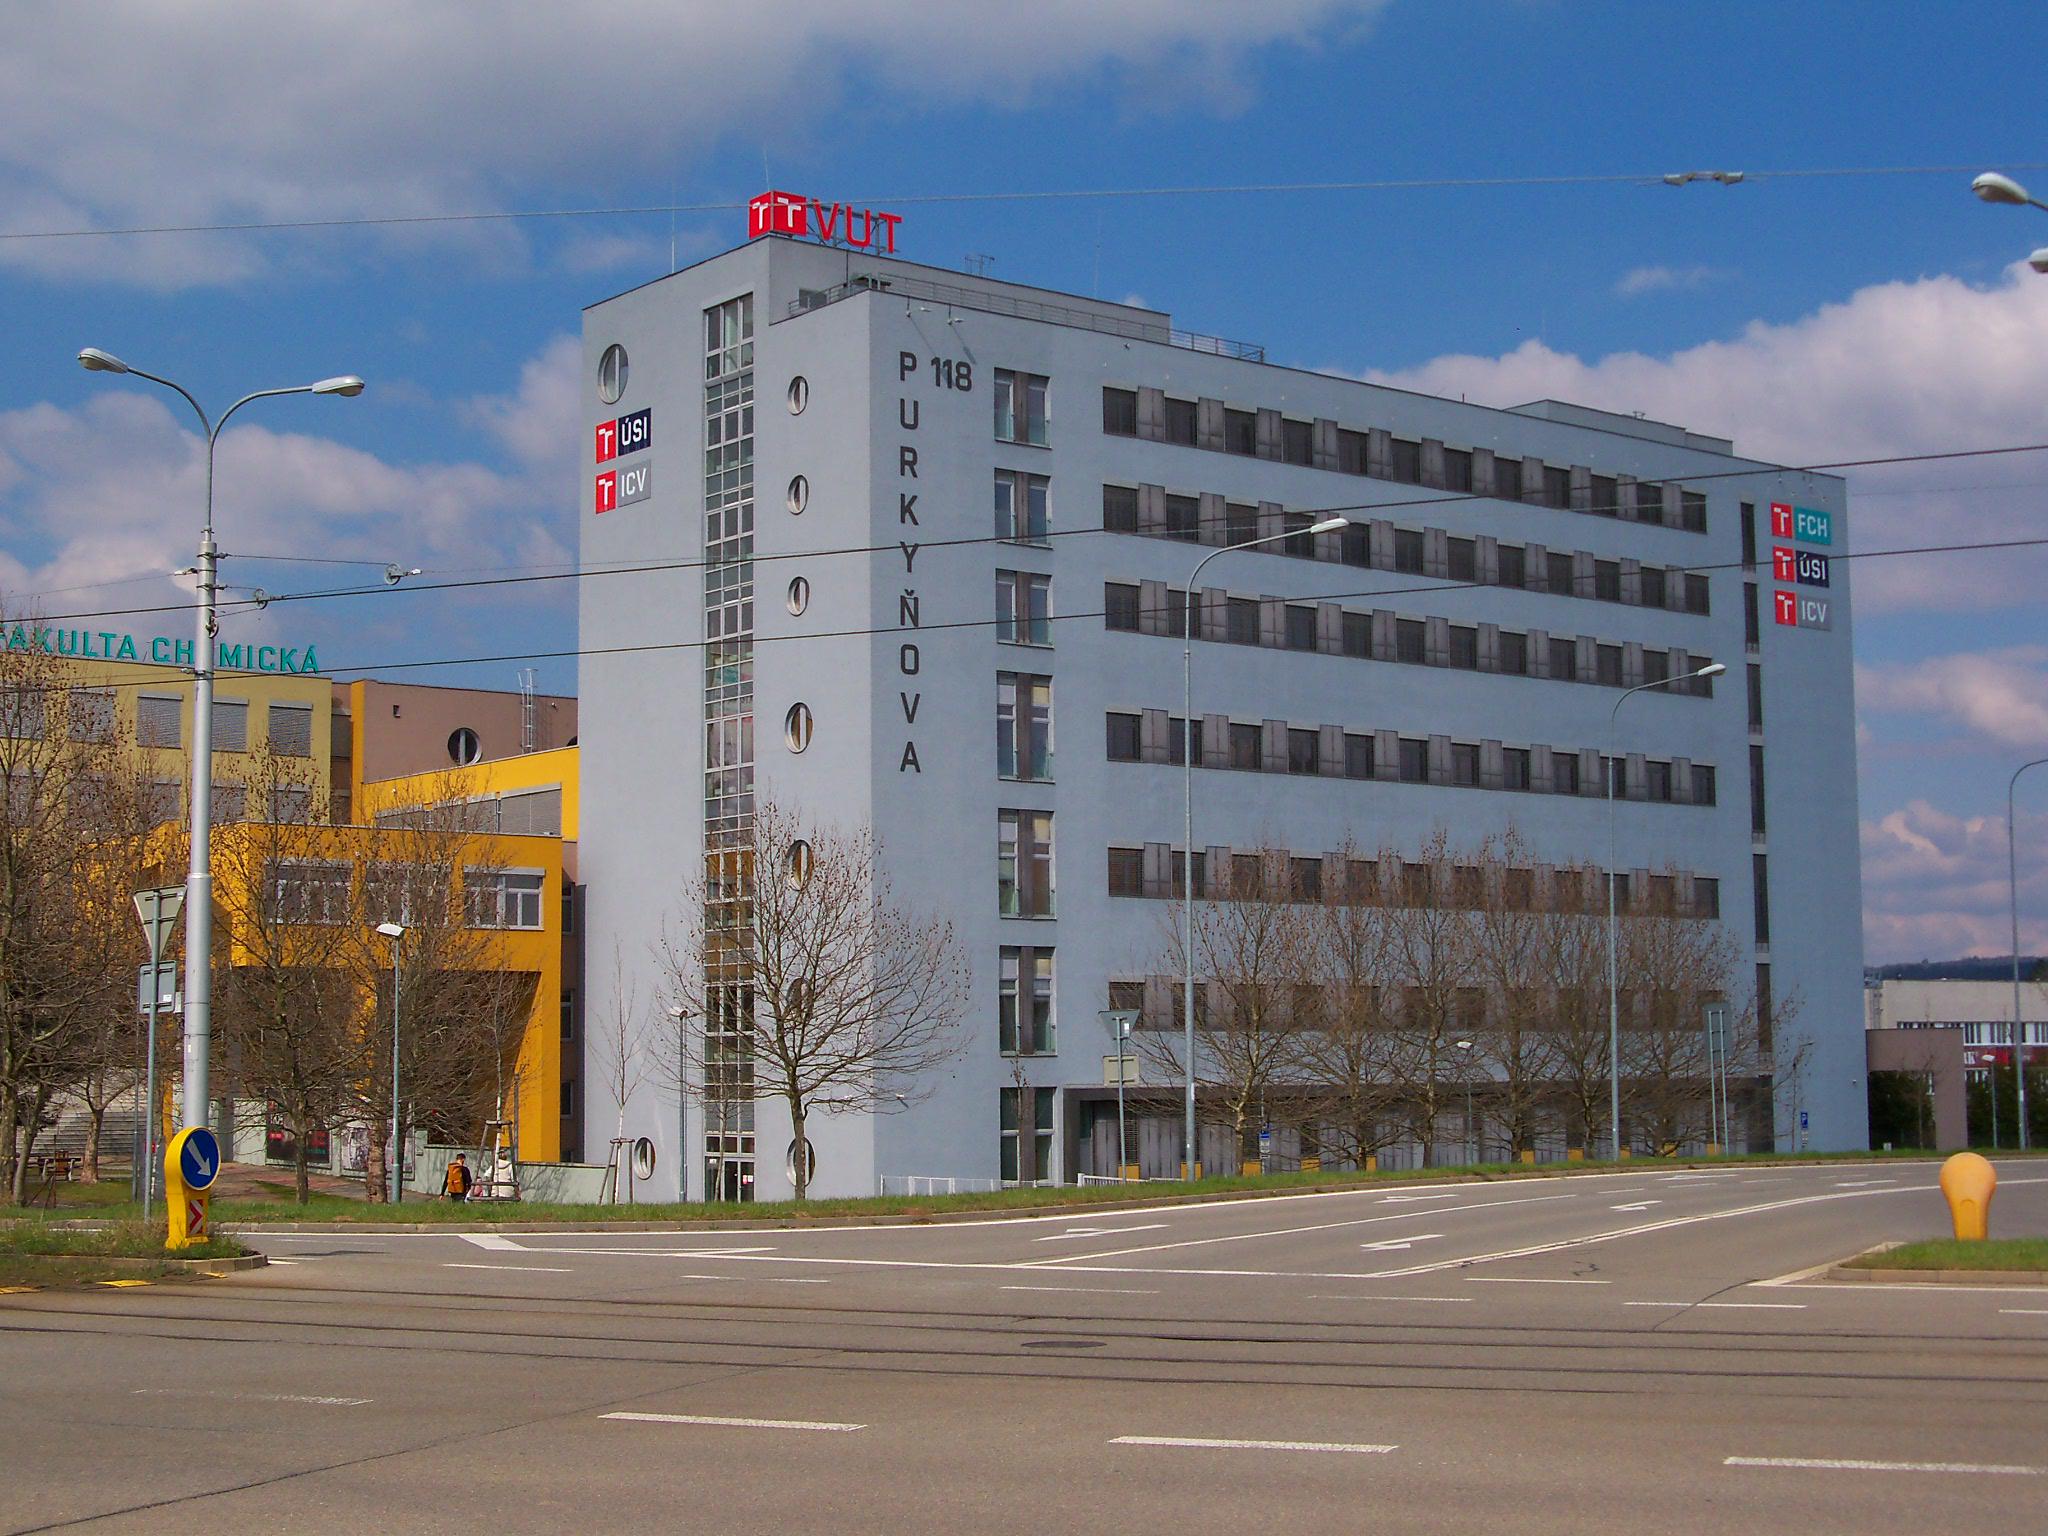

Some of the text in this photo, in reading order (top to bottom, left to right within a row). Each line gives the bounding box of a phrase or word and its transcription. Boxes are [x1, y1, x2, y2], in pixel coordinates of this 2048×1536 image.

[812, 198, 903, 254] VUT
[931, 356, 972, 391] 118
[621, 416, 648, 446] ÚSI
[621, 468, 647, 497] ICV
[1798, 514, 1828, 538] FCH
[900, 351, 921, 773] PURKYŇOVA
[1799, 553, 1827, 581] ÚSI
[1801, 599, 1827, 623] ICV
[152, 636, 319, 674] CHMICKÁ
